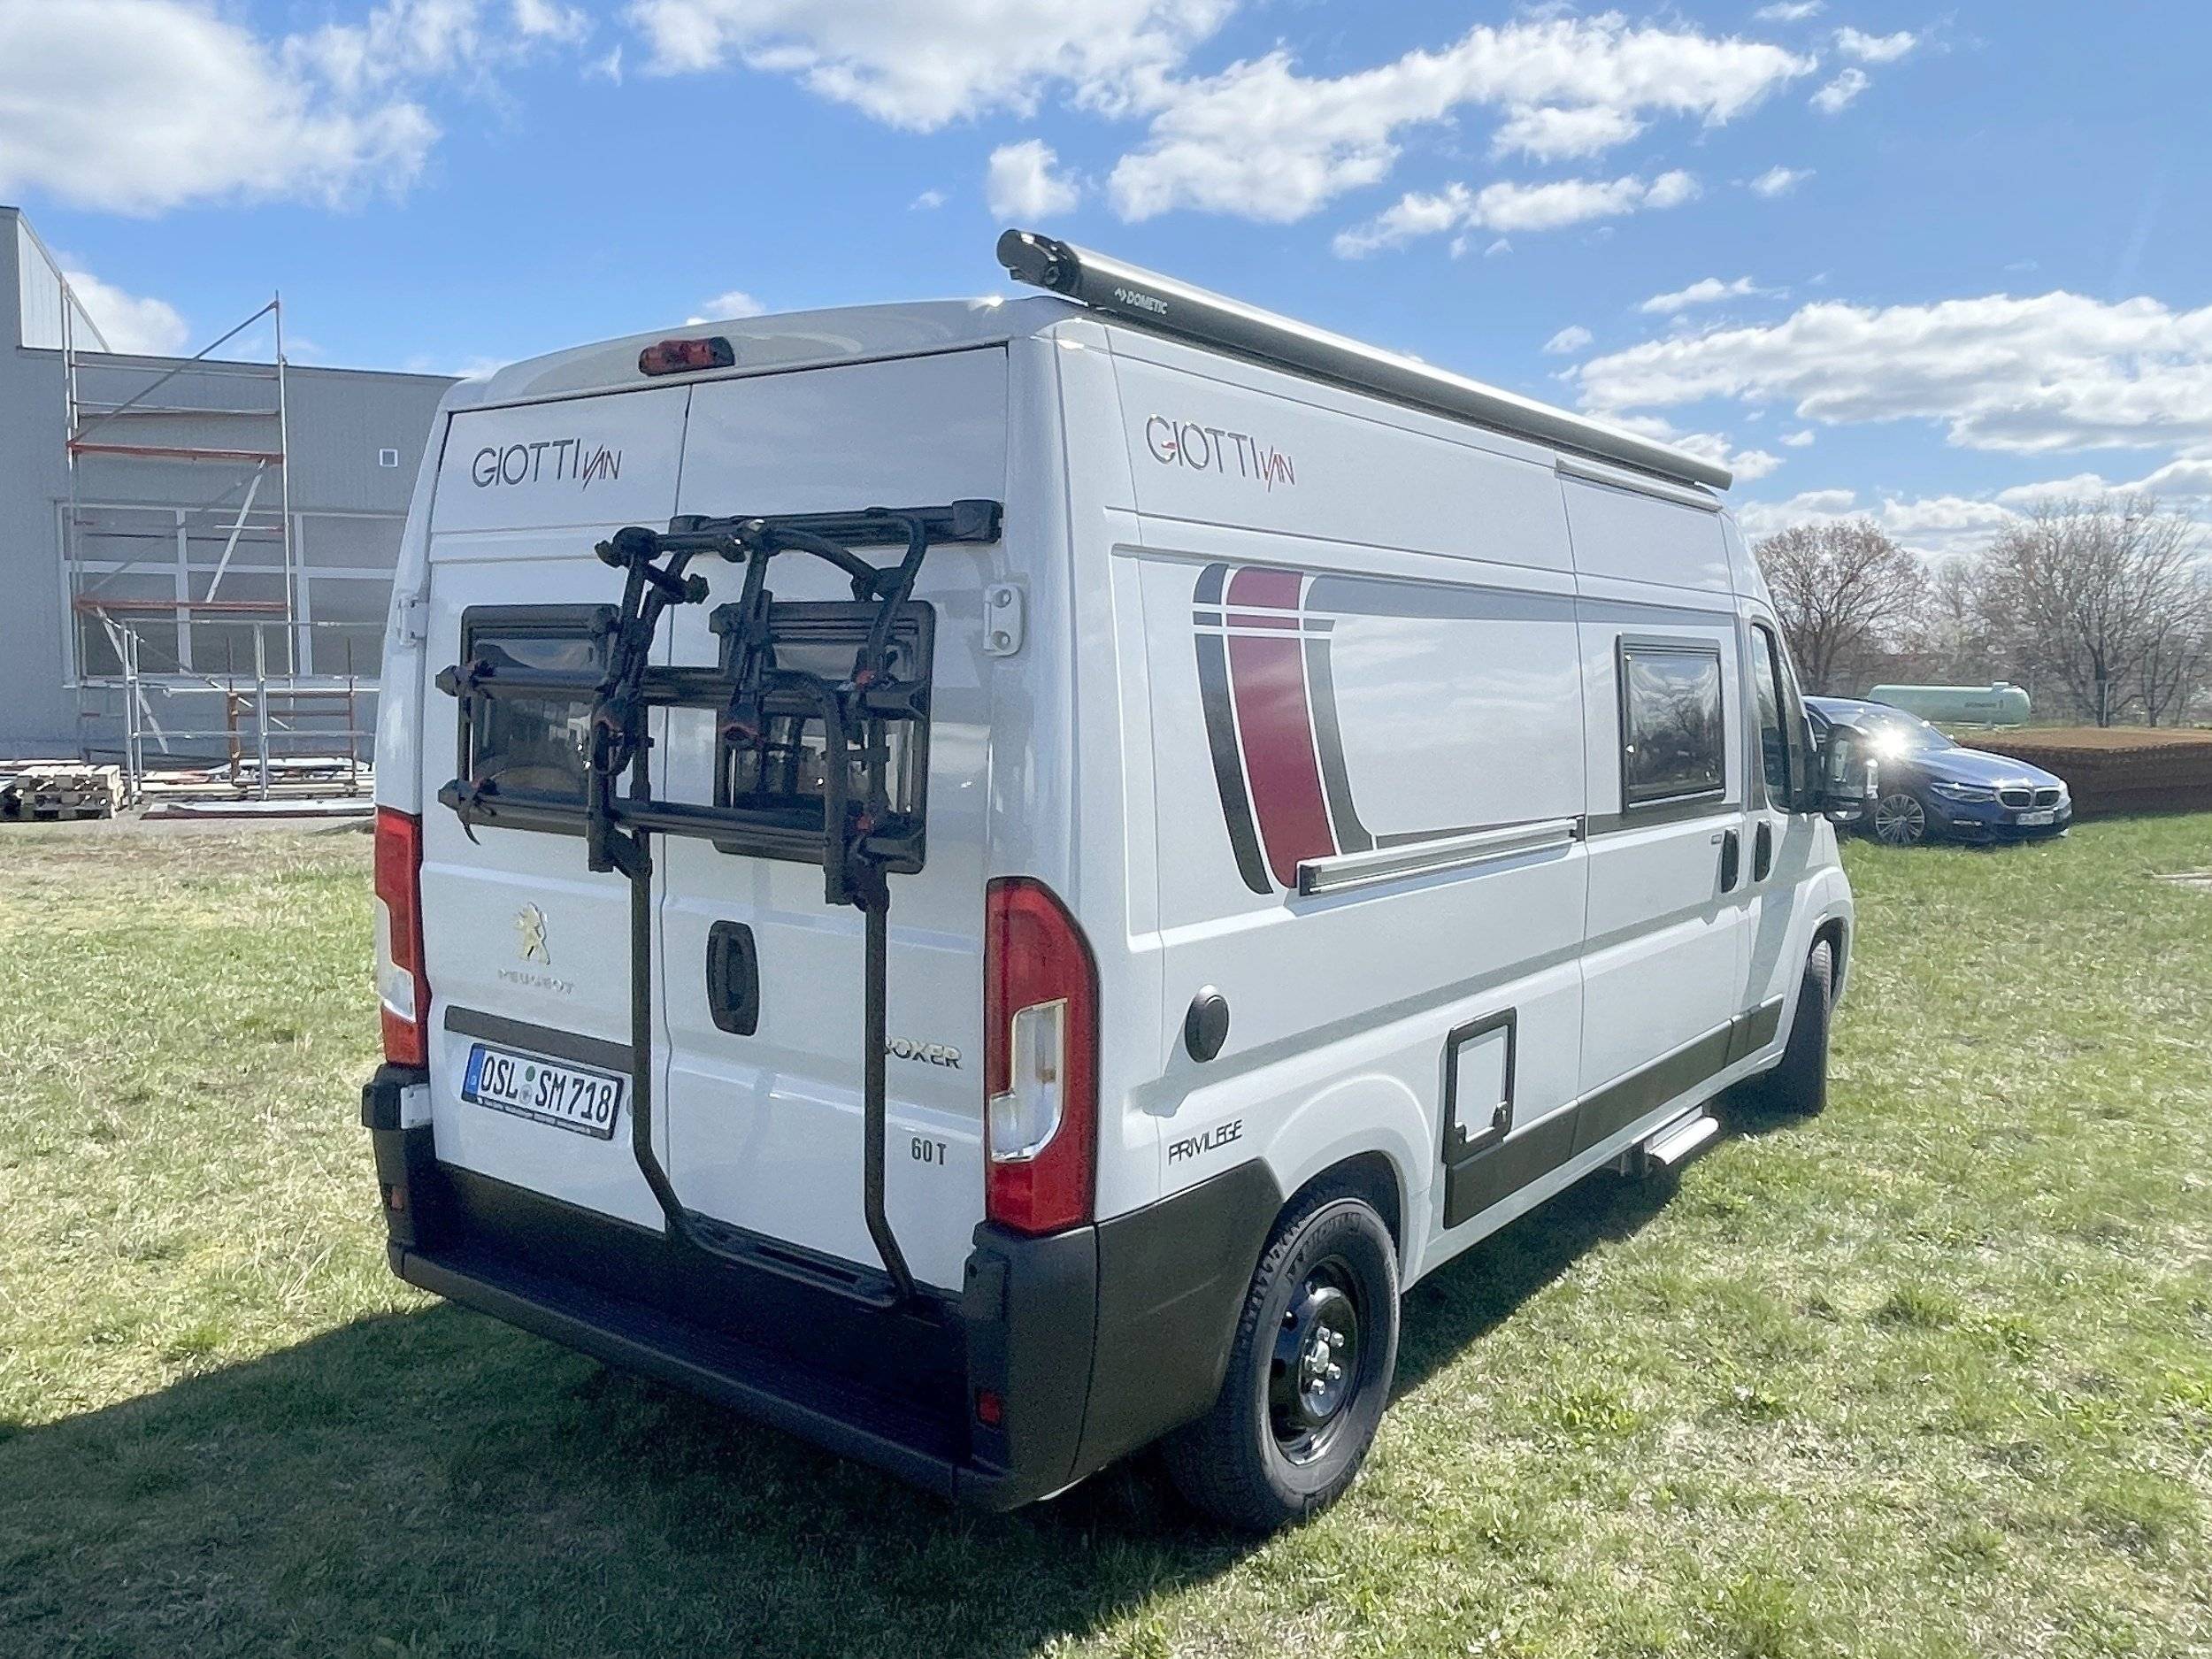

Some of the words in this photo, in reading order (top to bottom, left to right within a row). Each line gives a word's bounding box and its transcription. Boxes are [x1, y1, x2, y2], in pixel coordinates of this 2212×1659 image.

[1126, 290, 1168, 315] DOMETIC
[480, 1056, 518, 1099] OSL
[1168, 1119, 1242, 1166] PRIVILEGE
